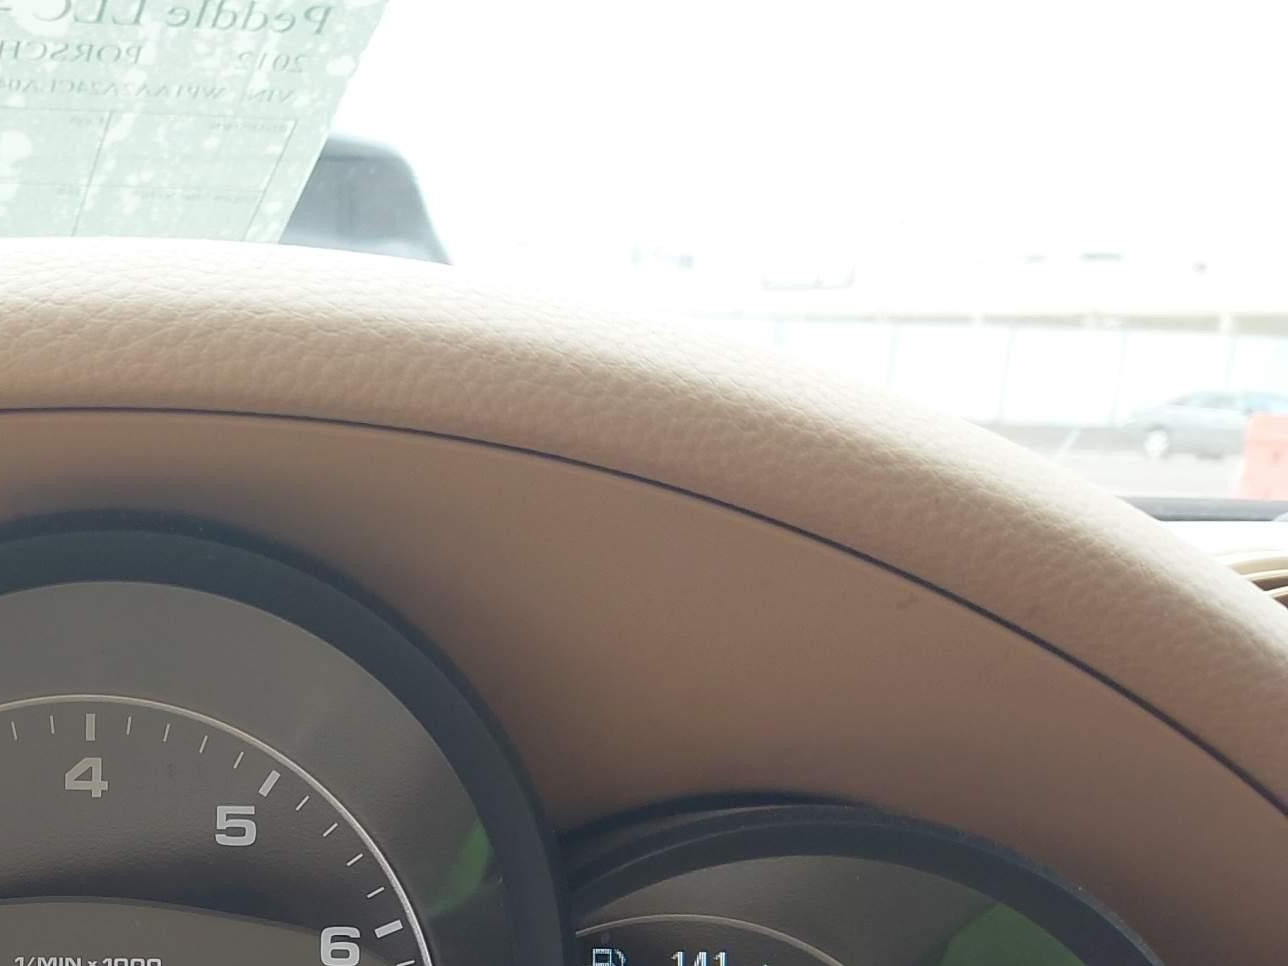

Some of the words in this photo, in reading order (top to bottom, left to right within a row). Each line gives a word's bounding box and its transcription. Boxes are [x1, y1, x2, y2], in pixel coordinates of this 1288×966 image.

[64, 758, 108, 797] 4
[215, 806, 257, 846] 5
[320, 927, 360, 966] 6
